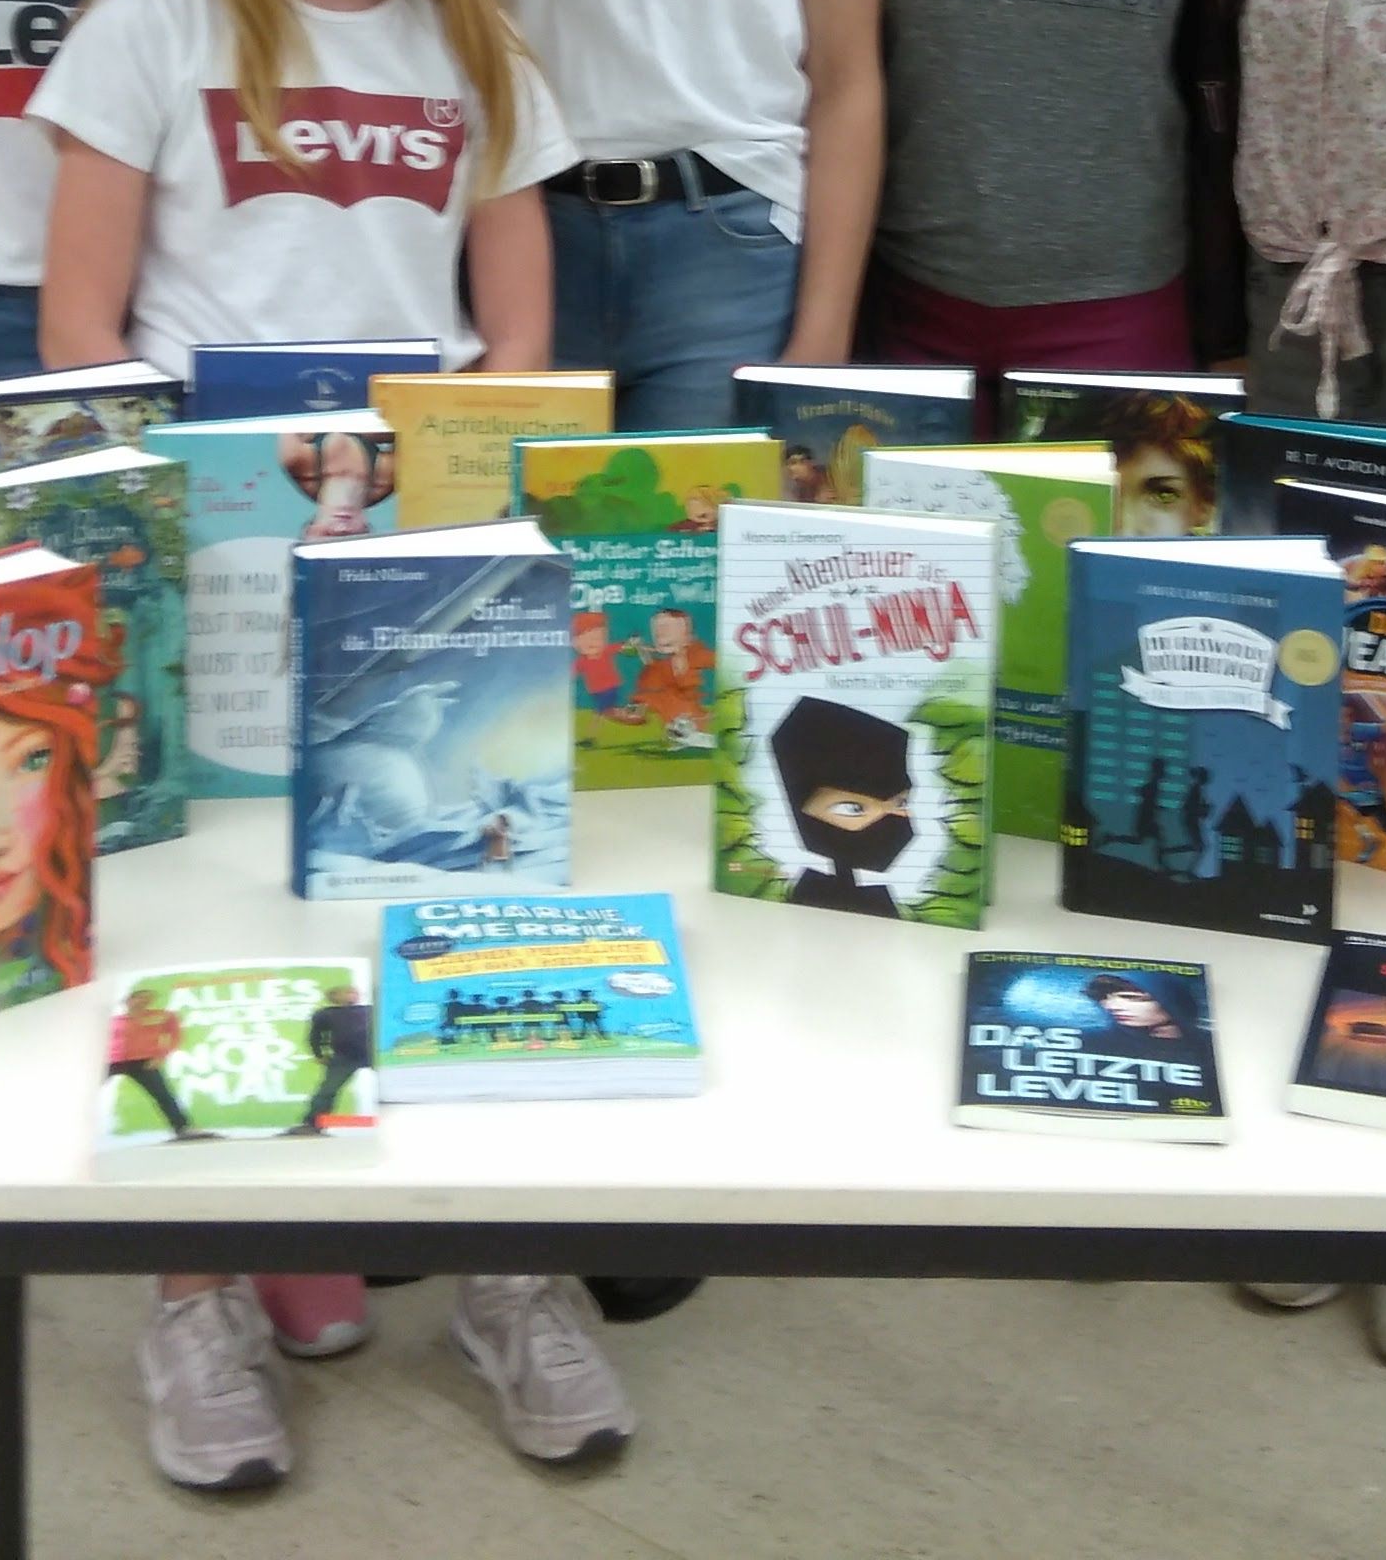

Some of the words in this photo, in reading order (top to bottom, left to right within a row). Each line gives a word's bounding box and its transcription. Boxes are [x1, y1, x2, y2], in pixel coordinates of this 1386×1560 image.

[446, 454, 513, 477] Bakla
[783, 544, 916, 595] Abenteuer
[414, 902, 625, 923] CHARLIE
[421, 922, 646, 940] MERRICK
[165, 977, 326, 1011] ALLES
[968, 1024, 1084, 1050] DAS
[1001, 1048, 1204, 1088] LETZTE
[976, 1072, 1160, 1107] LEVEL
